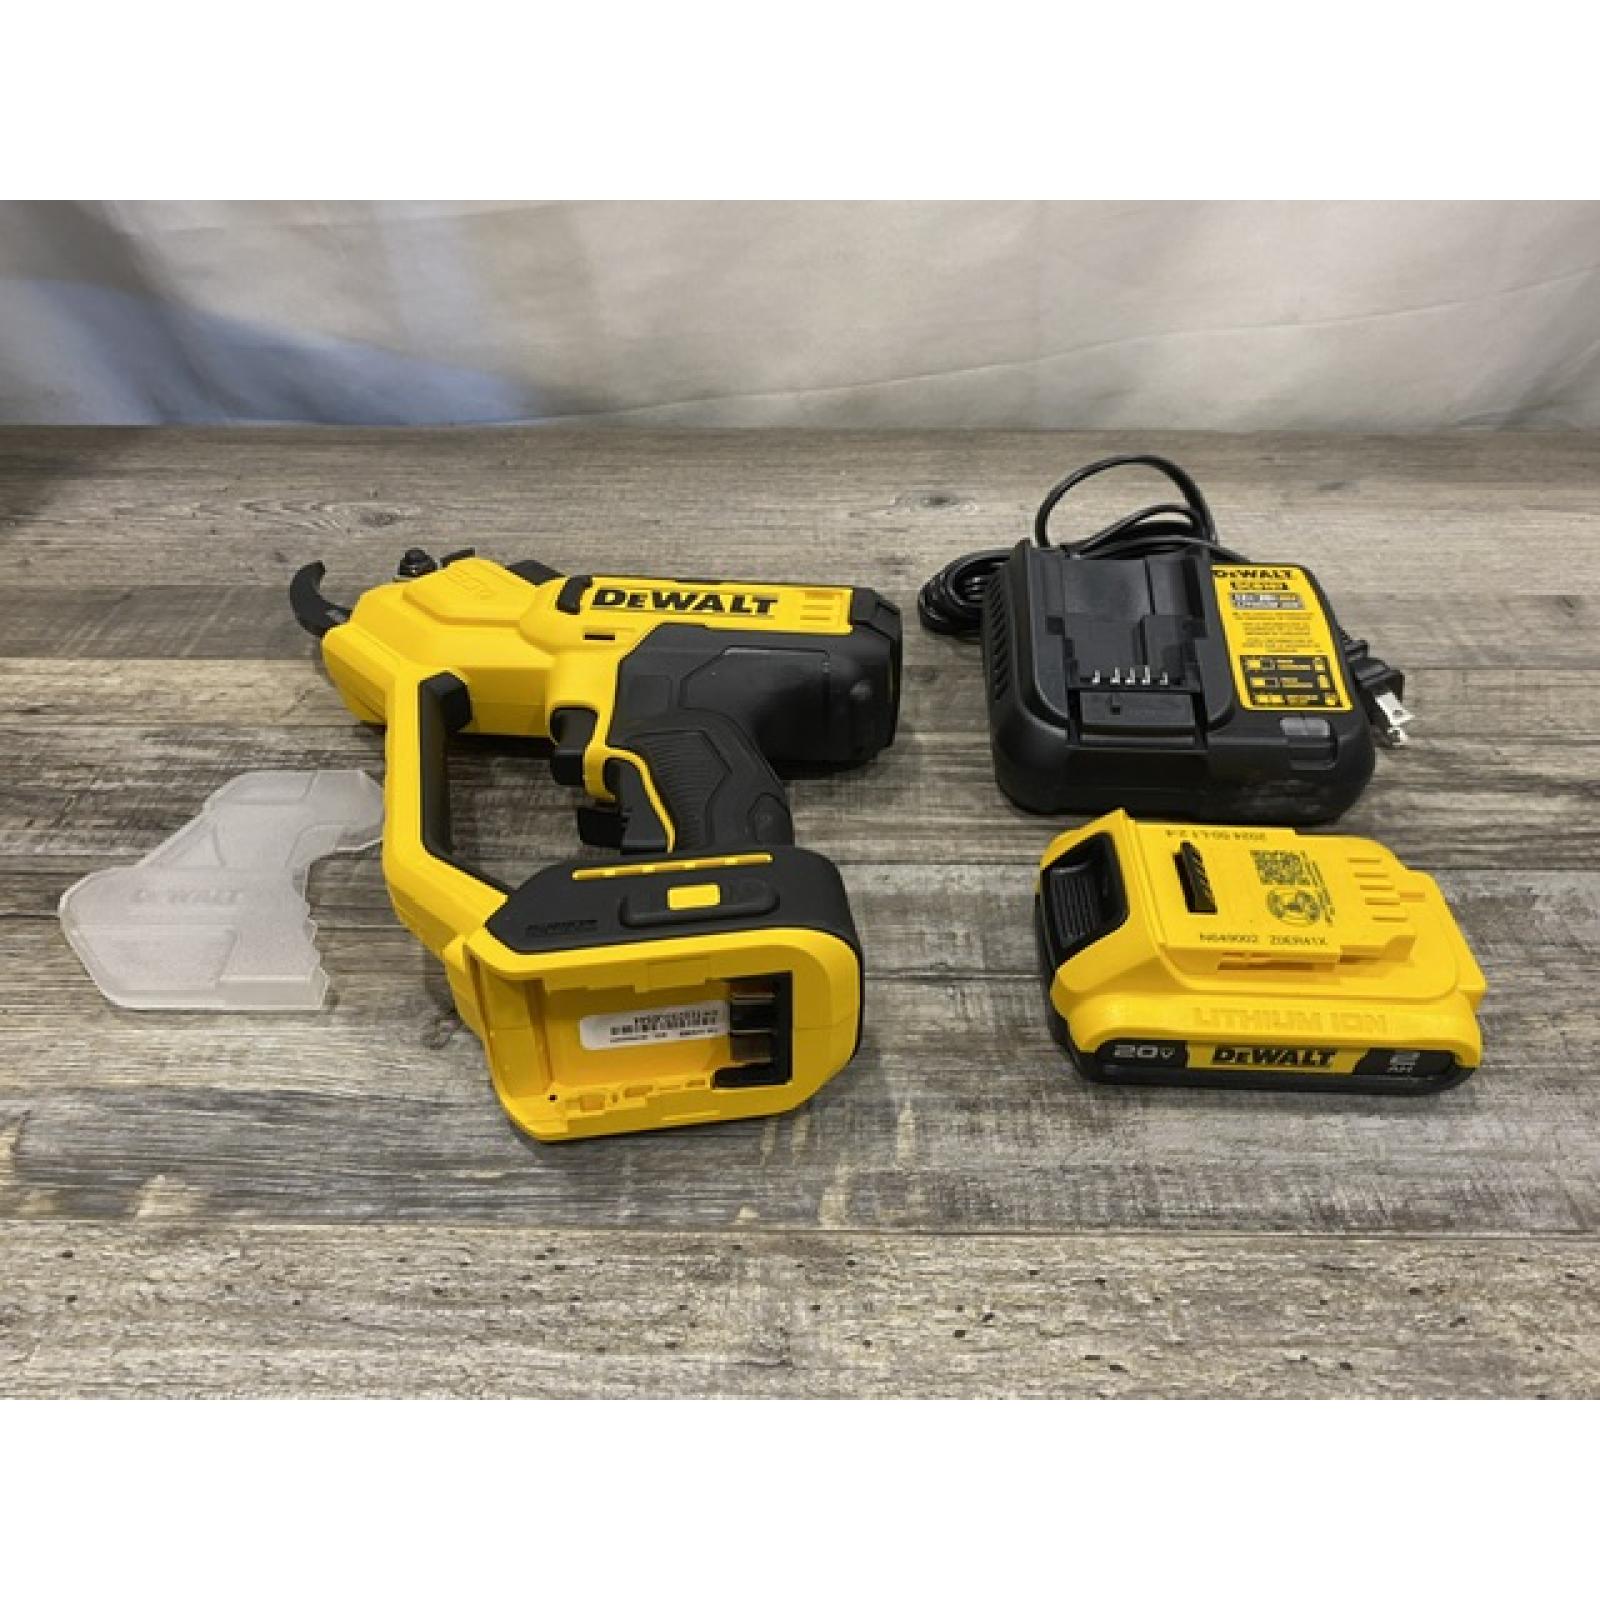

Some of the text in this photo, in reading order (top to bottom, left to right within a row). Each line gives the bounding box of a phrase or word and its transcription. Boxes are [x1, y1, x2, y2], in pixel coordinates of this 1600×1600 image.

[592, 588, 778, 614] DEWALT
[1192, 1007, 1387, 1035] LITHIUM ION
[1211, 1047, 1337, 1066] DEWALT
